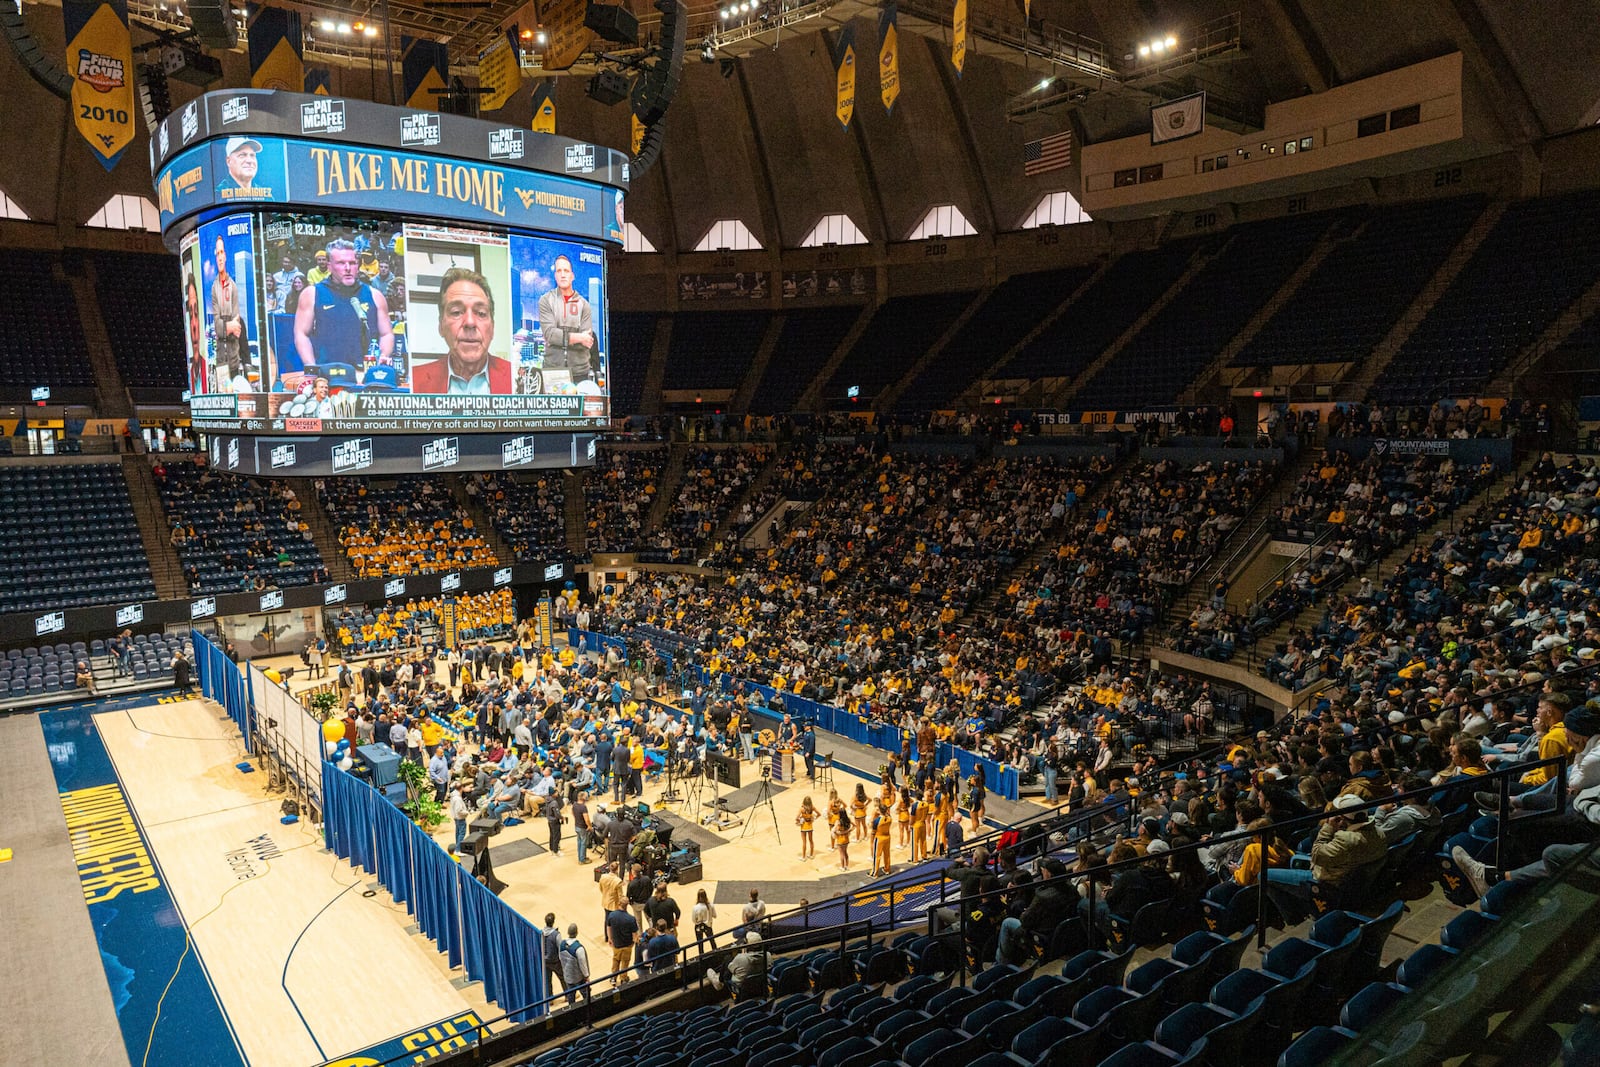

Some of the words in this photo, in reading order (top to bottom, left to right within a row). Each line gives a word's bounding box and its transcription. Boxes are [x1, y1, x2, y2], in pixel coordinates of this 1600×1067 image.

[91, 54, 122, 69] FINAL
[79, 60, 123, 80] FOUR
[80, 104, 128, 124] 2010
[314, 100, 332, 114] PAT
[304, 112, 342, 128] MCAFEE
[412, 114, 428, 126] PAT
[403, 126, 438, 140] MCAFEE
[499, 129, 513, 141] PAT
[492, 140, 522, 154] MCAFEE
[574, 144, 586, 156] PAT
[567, 155, 593, 168] MCAFEE
[310, 148, 384, 196] TAKE
[390, 157, 430, 194] ME
[435, 162, 506, 217] HOME
[1434, 168, 1462, 187] 212
[535, 191, 585, 212] MOUNTAINEER
[1194, 213, 1216, 227] 210
[295, 223, 325, 236] 12.13.24
[925, 244, 947, 256] 208
[360, 396, 376, 409] 7X
[378, 397, 433, 409] NATIONAL
[436, 397, 490, 409] CHAMPION
[492, 397, 524, 408] COACH
[527, 397, 548, 408] NICK
[550, 397, 578, 408] SABAN
[336, 421, 360, 429] them
[413, 420, 442, 430] they're
[481, 418, 496, 429] lazy
[503, 418, 522, 427] don't
[1058, 414, 1070, 424] GO
[1091, 413, 1107, 424] 108
[96, 424, 114, 435] 101
[344, 439, 360, 451] PAT
[433, 438, 448, 451] PAT
[512, 436, 525, 450] PAT
[335, 449, 370, 468] MCAFEE
[425, 448, 457, 466] MCAFEE
[504, 446, 532, 463] MCAFEE
[60, 783, 160, 904] MOUNTAINEERS
